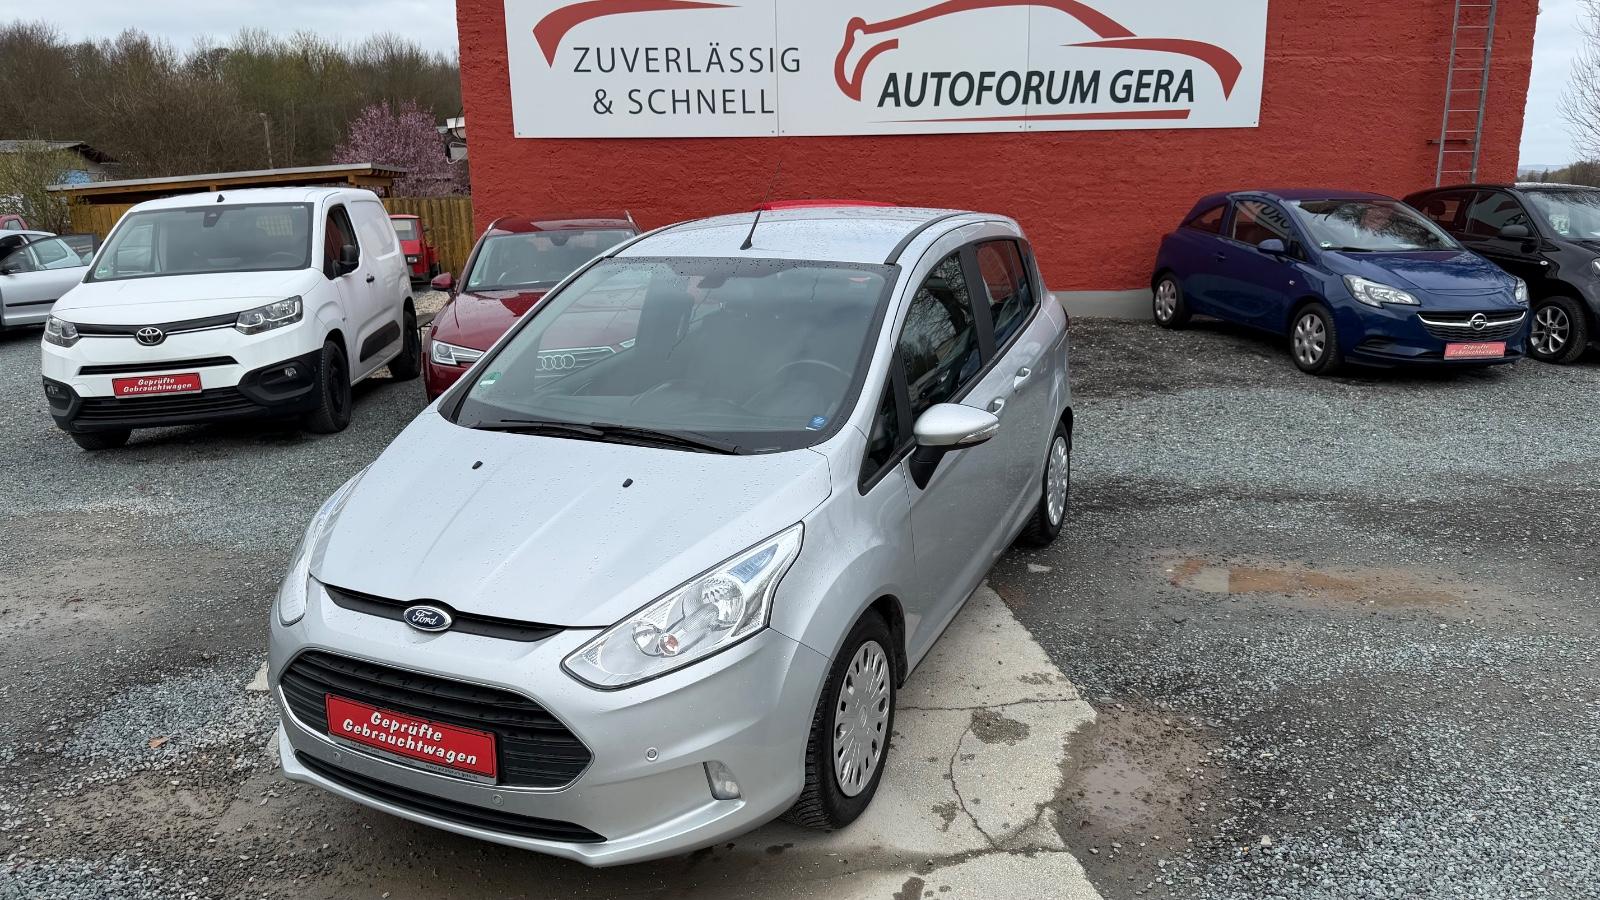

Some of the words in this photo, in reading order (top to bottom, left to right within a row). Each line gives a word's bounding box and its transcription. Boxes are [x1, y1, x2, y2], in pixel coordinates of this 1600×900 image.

[573, 42, 801, 73] ZUVERLÄSSIG
[593, 88, 613, 115] &
[628, 88, 775, 115] SCHNELL
[877, 70, 1100, 108] AUTOFORUM
[1109, 69, 1194, 104] GERA
[123, 383, 192, 393] Gebrauchtwagen
[138, 377, 175, 387] Geprüfte
[412, 610, 439, 625] Ford
[370, 711, 443, 742] Geprüfte
[342, 718, 477, 765] Gebrauchtwagen
